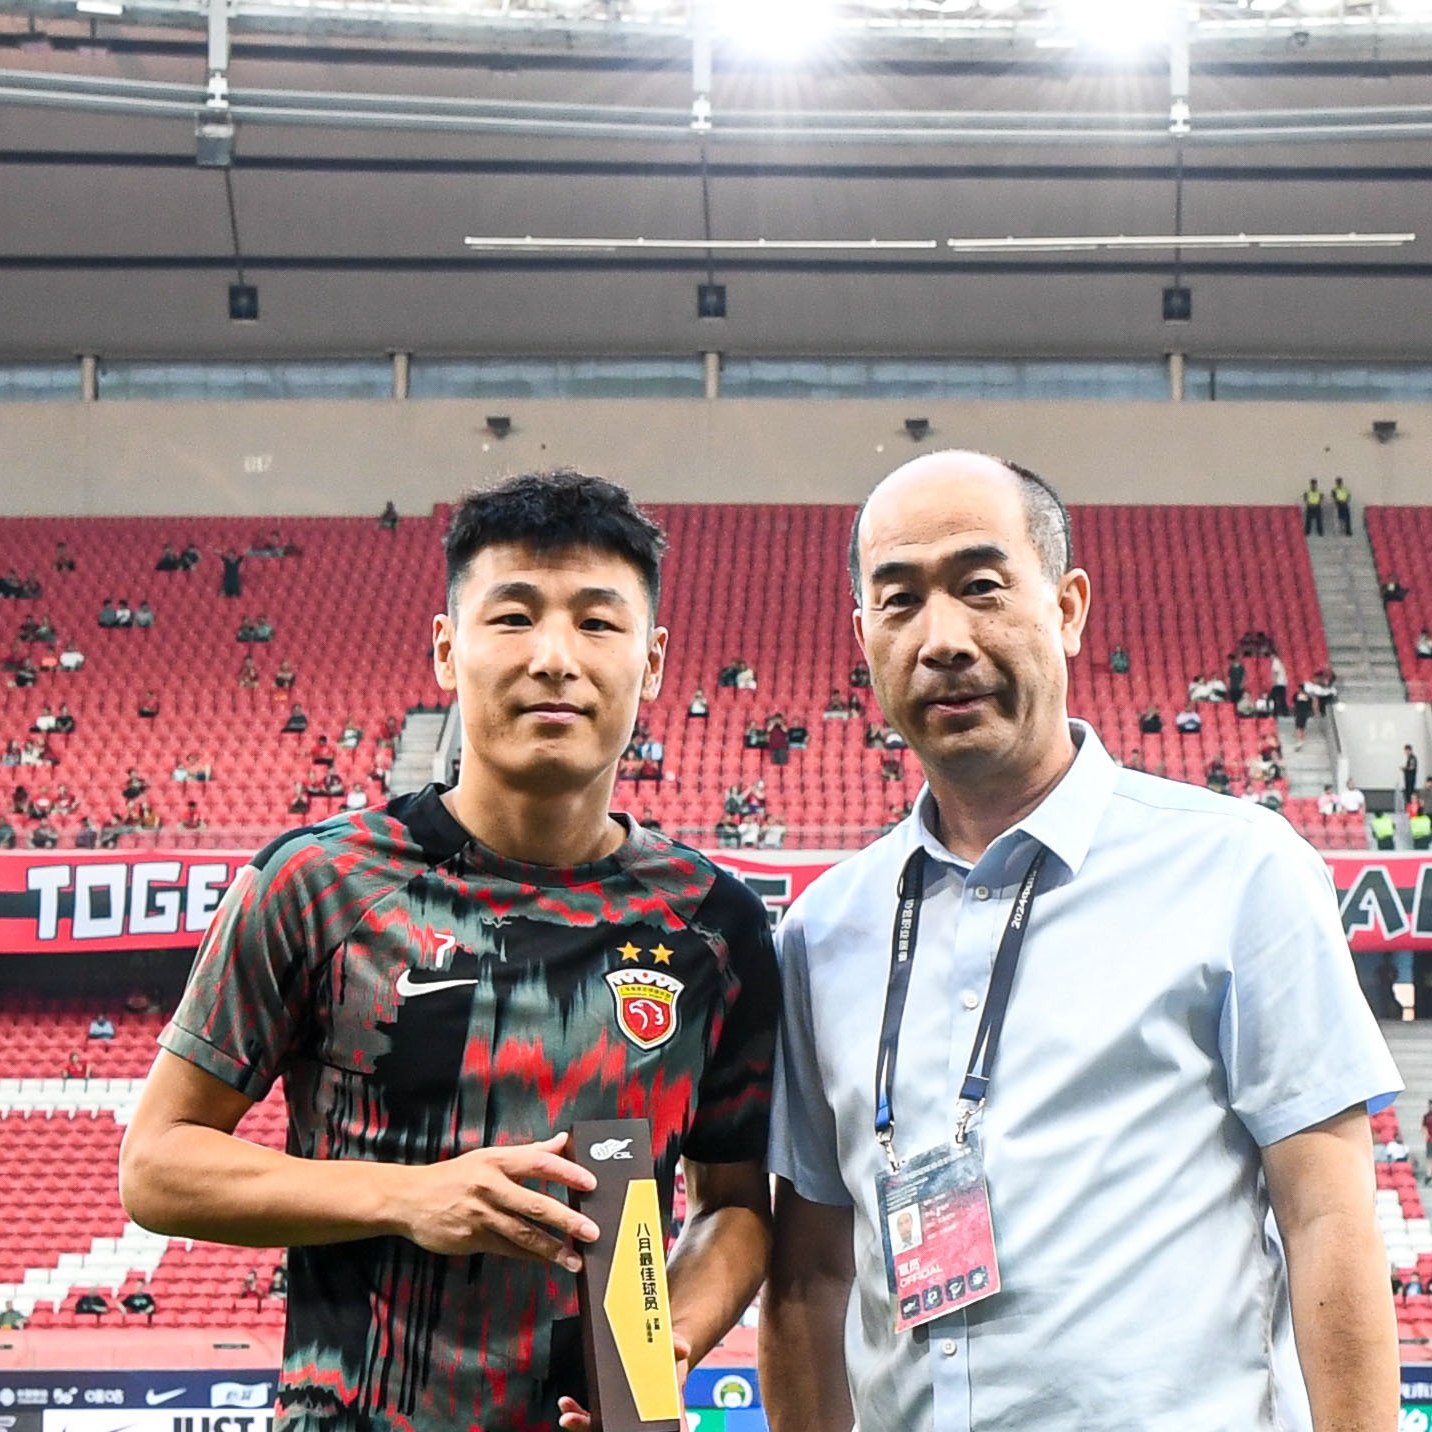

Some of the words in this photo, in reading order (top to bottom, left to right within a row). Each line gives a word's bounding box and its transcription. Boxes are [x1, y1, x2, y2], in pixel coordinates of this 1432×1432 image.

[27, 860, 243, 941] TOGE
[434, 932, 456, 969] 7
[636, 1222, 659, 1311] 八月最佳球员
